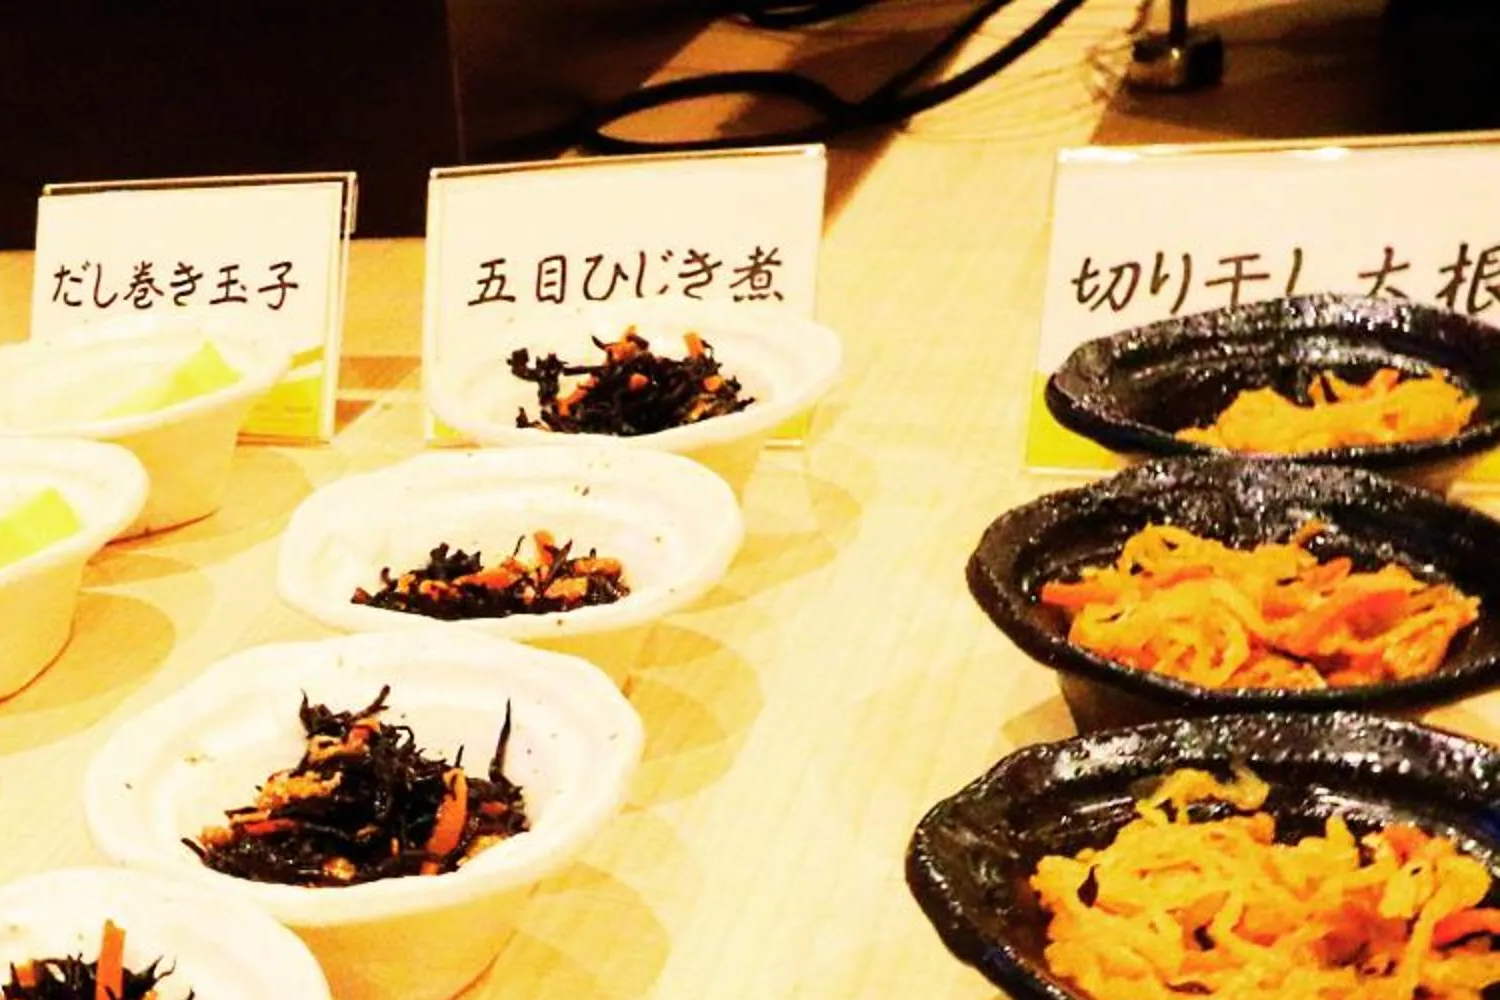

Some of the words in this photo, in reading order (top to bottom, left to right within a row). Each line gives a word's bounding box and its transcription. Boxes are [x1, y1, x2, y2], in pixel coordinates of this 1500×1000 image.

[52, 259, 300, 311] だし巻き玉子
[467, 245, 784, 305] 五目ひじき煮
